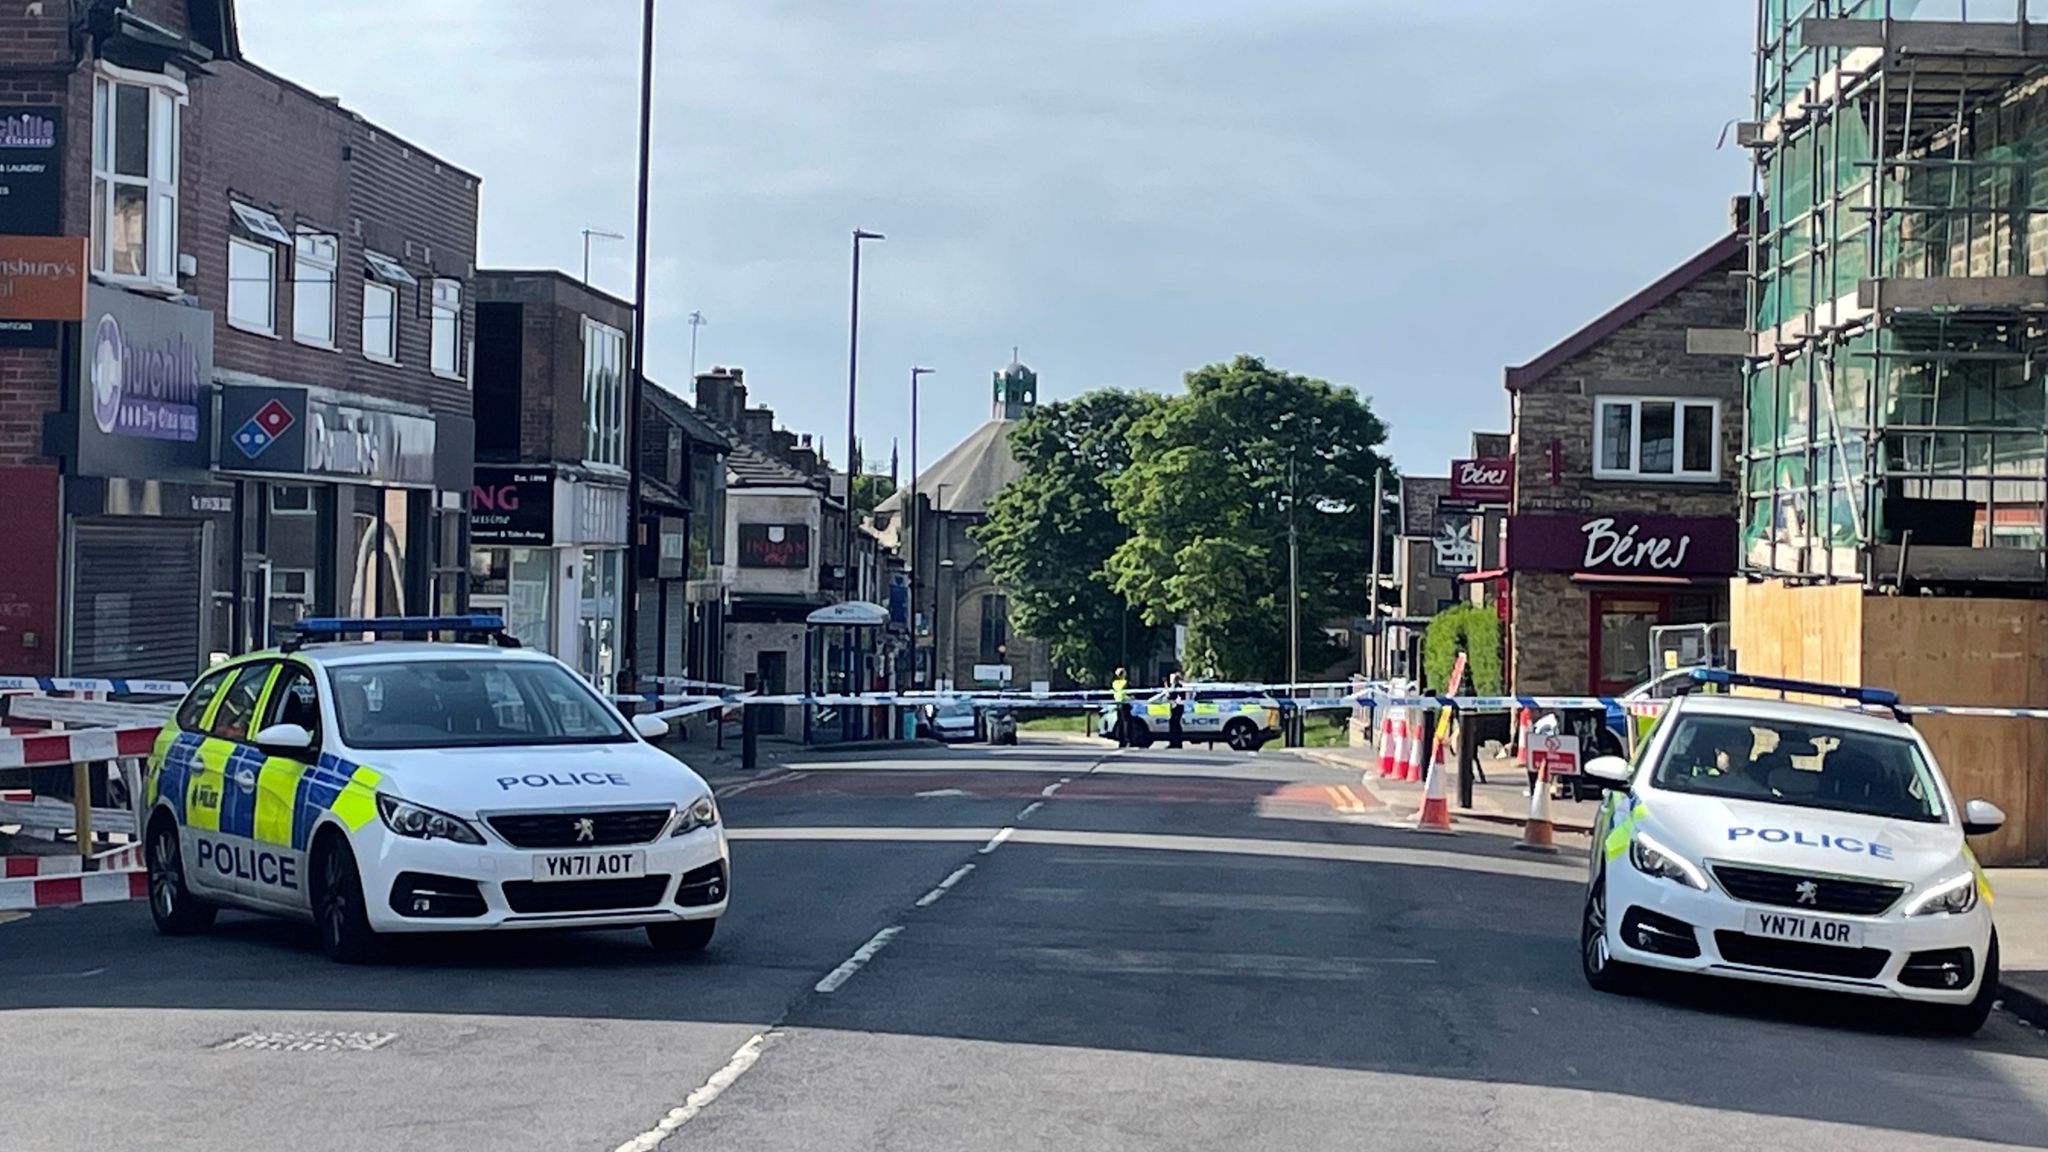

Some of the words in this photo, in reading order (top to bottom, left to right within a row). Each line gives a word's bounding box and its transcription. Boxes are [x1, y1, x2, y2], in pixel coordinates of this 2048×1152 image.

[1460, 462, 1507, 484] Béres
[1581, 518, 1690, 569] Béres
[143, 683, 172, 692] POLICE
[1155, 717, 1220, 726] PLICE
[497, 772, 631, 790] POLICE
[1727, 827, 1895, 861] POLICE
[197, 838, 299, 891] POLICE
[546, 856, 591, 876] YN71
[596, 854, 633, 874] AOT
[1759, 913, 1805, 937] YN71
[1810, 920, 1851, 941] AOR
